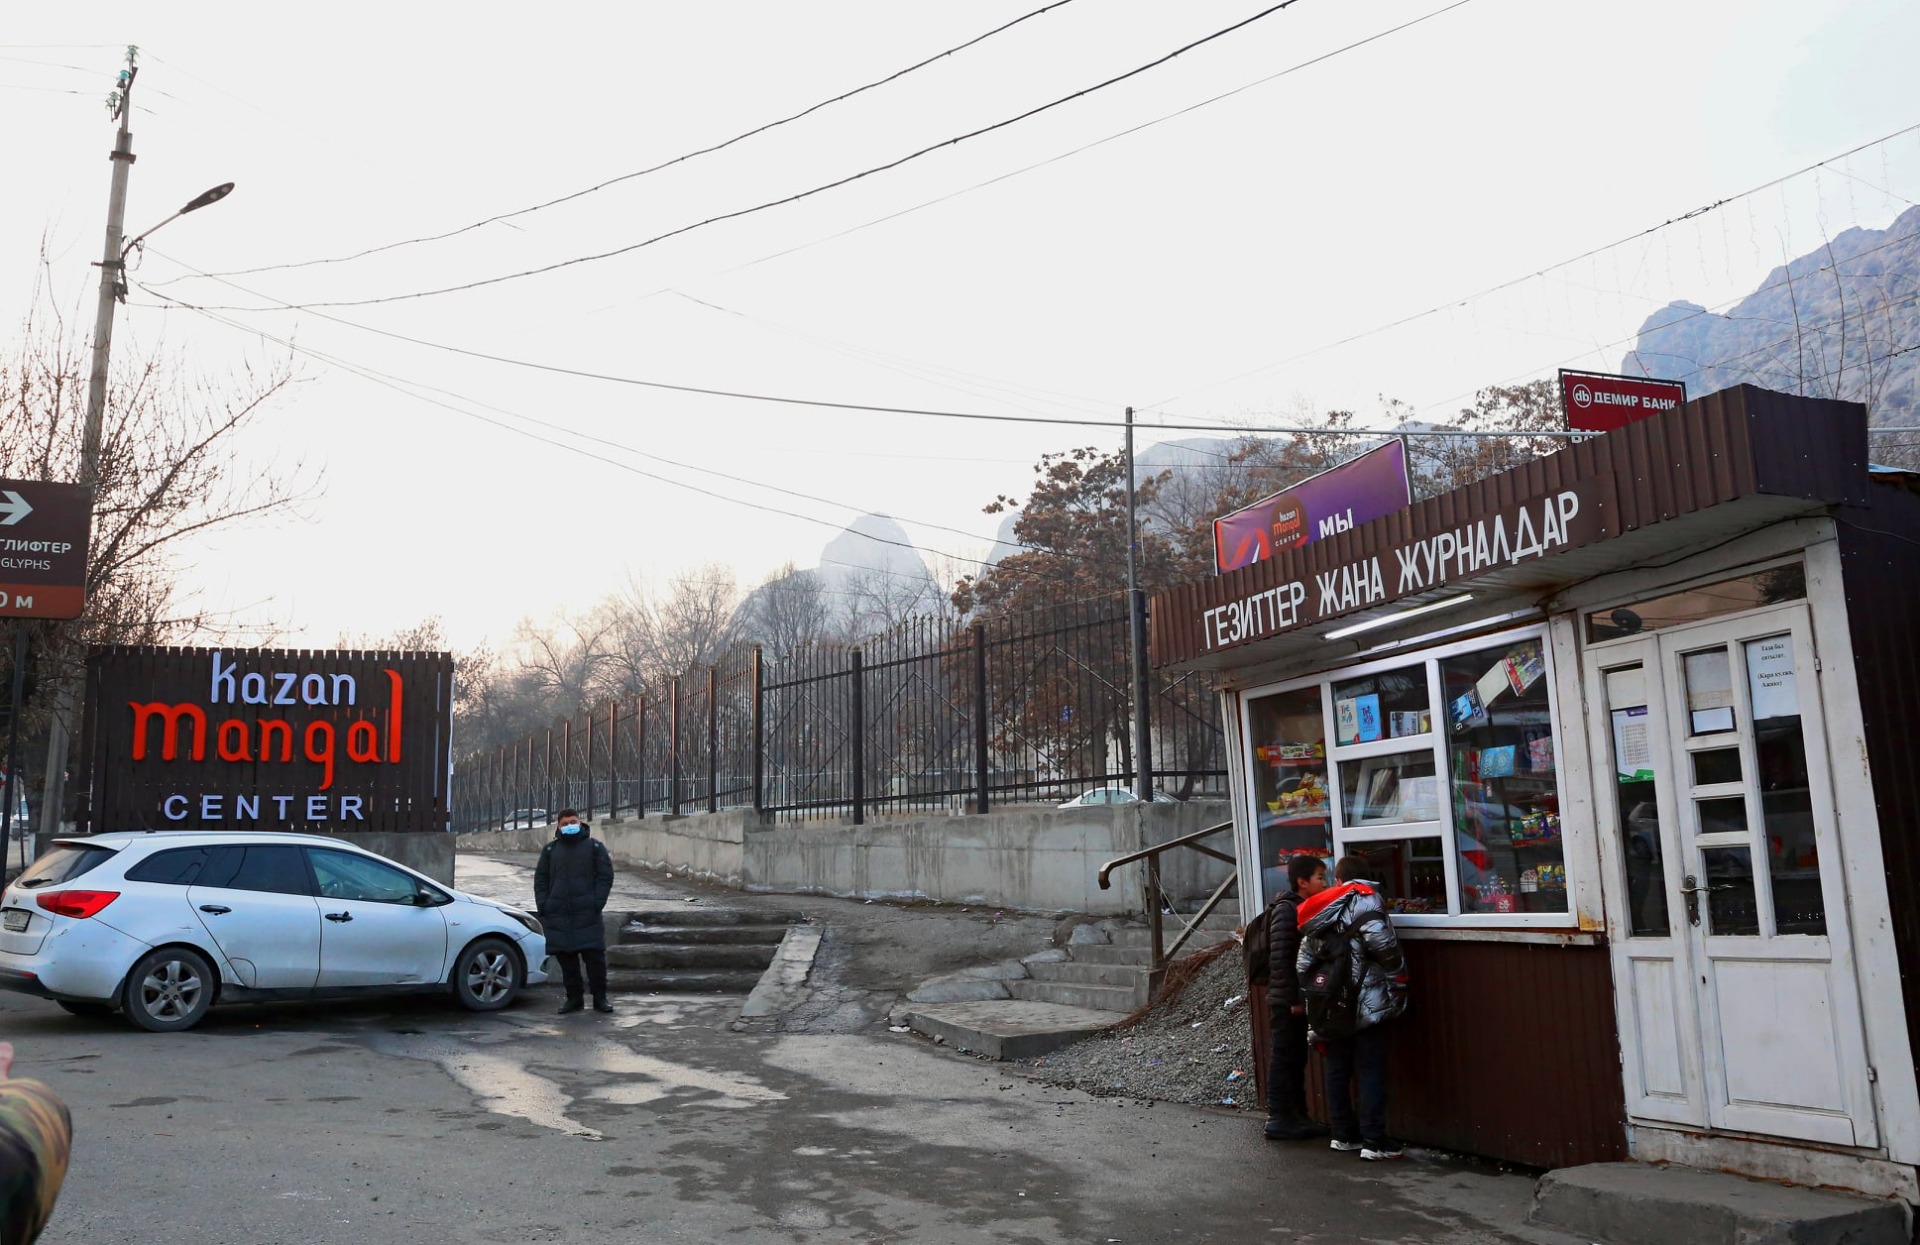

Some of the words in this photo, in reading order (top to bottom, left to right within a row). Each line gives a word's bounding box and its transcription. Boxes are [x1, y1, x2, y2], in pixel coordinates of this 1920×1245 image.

[1594, 391, 1638, 406] ДЕМИР
[1643, 396, 1676, 410] БАНК
[1275, 533, 1301, 546] CENTER
[1203, 581, 1306, 650] ГЕЗИТТЕР
[1316, 556, 1386, 618] ЖАНА
[1395, 491, 1580, 595] ЖУРНАЛДАР
[211, 651, 356, 706] kazan
[128, 669, 402, 791] mangal
[164, 794, 365, 821] CENTER
